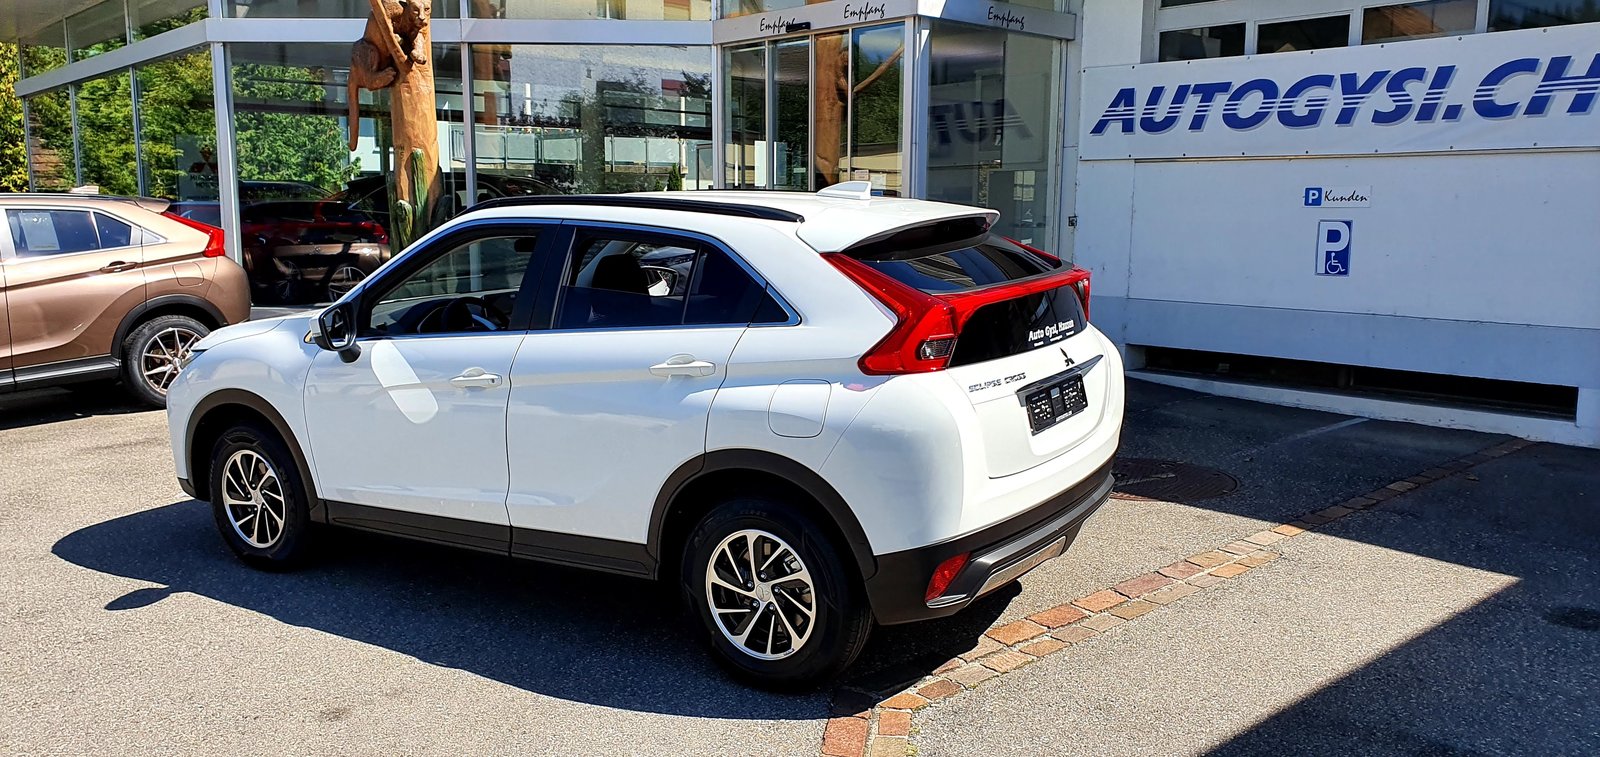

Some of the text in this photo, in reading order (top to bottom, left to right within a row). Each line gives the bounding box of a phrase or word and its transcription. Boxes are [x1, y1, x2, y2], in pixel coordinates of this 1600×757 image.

[843, 2, 886, 21] Empfang
[987, 6, 1025, 30] Empfang
[1090, 53, 1600, 135] AUTOGYSI.CH
[1308, 189, 1368, 204] P Kunden
[1028, 329, 1045, 342] Auto
[968, 372, 1026, 393] ECLIPSE CROSS
